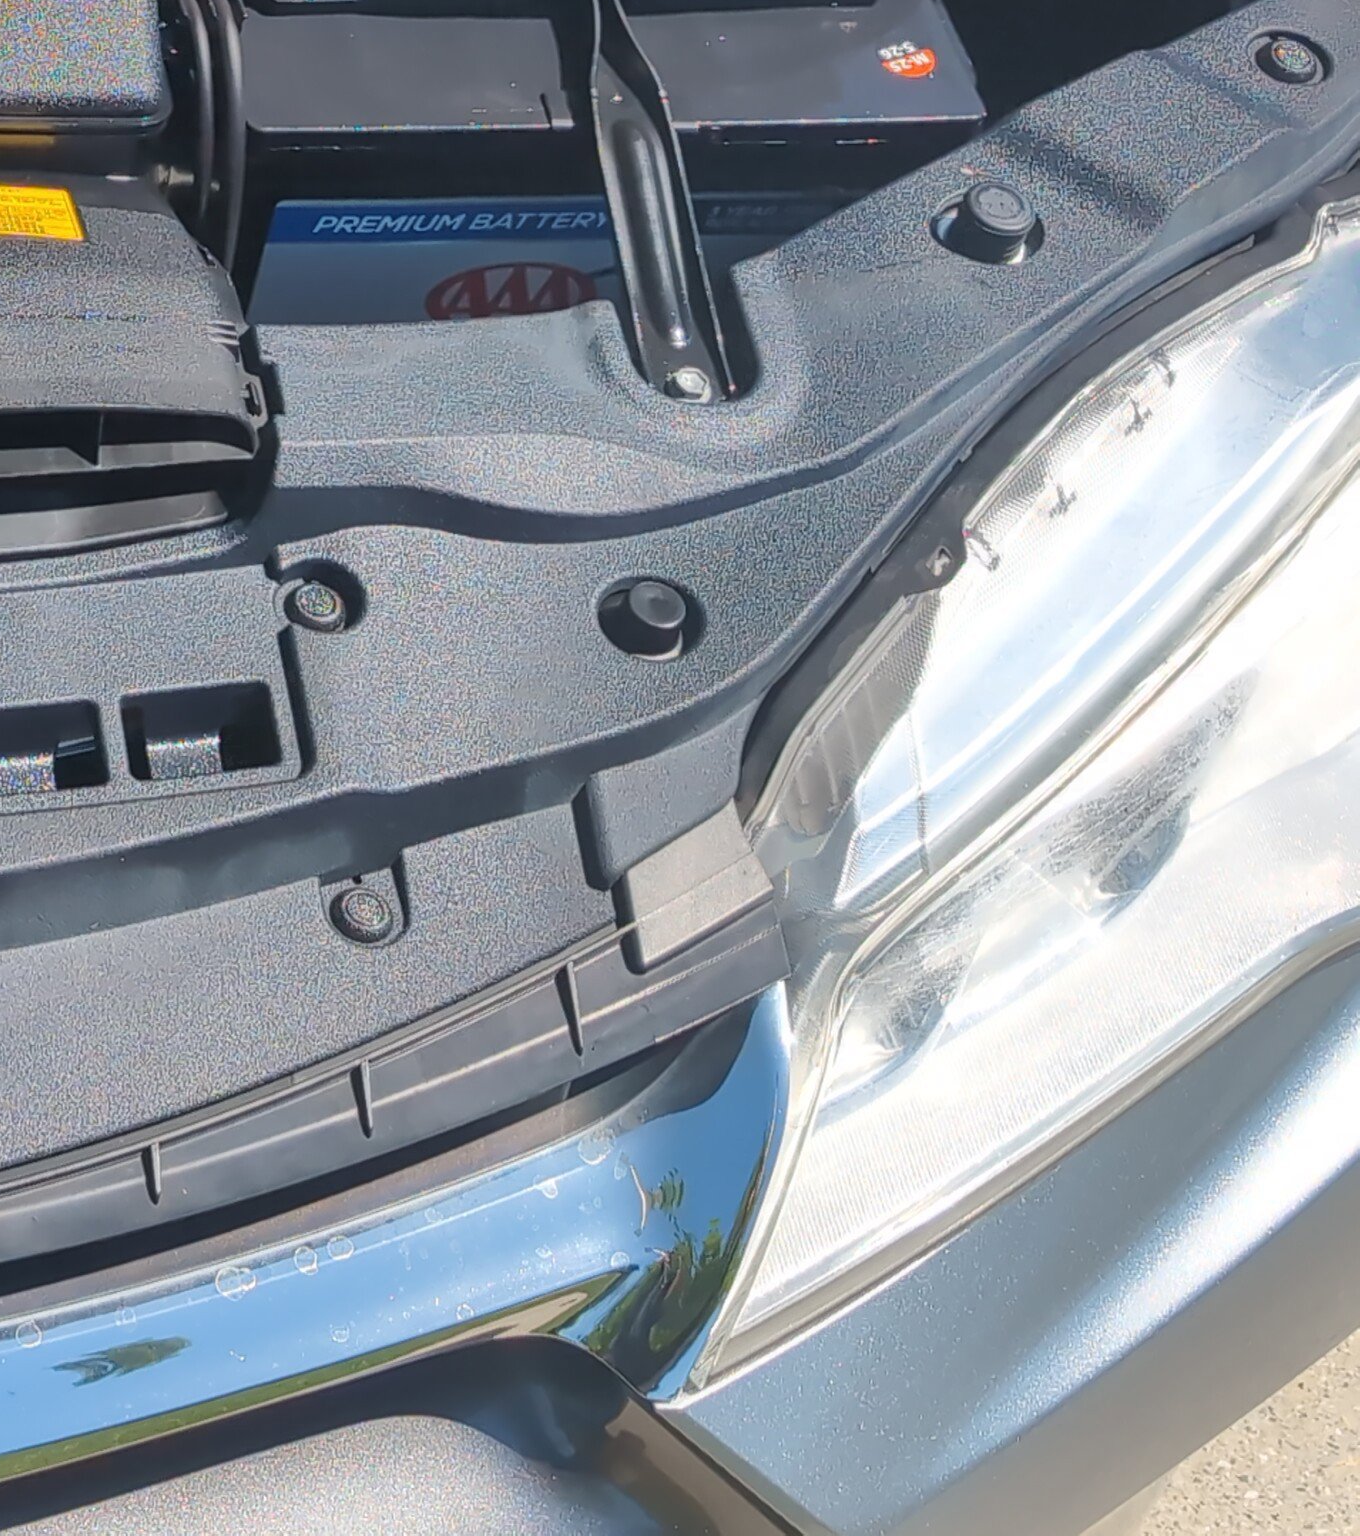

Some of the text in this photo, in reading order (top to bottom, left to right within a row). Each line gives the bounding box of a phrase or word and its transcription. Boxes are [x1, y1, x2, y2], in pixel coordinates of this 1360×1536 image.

[311, 211, 608, 235] PREMIUM BATTERY
[435, 264, 588, 320] AAA
